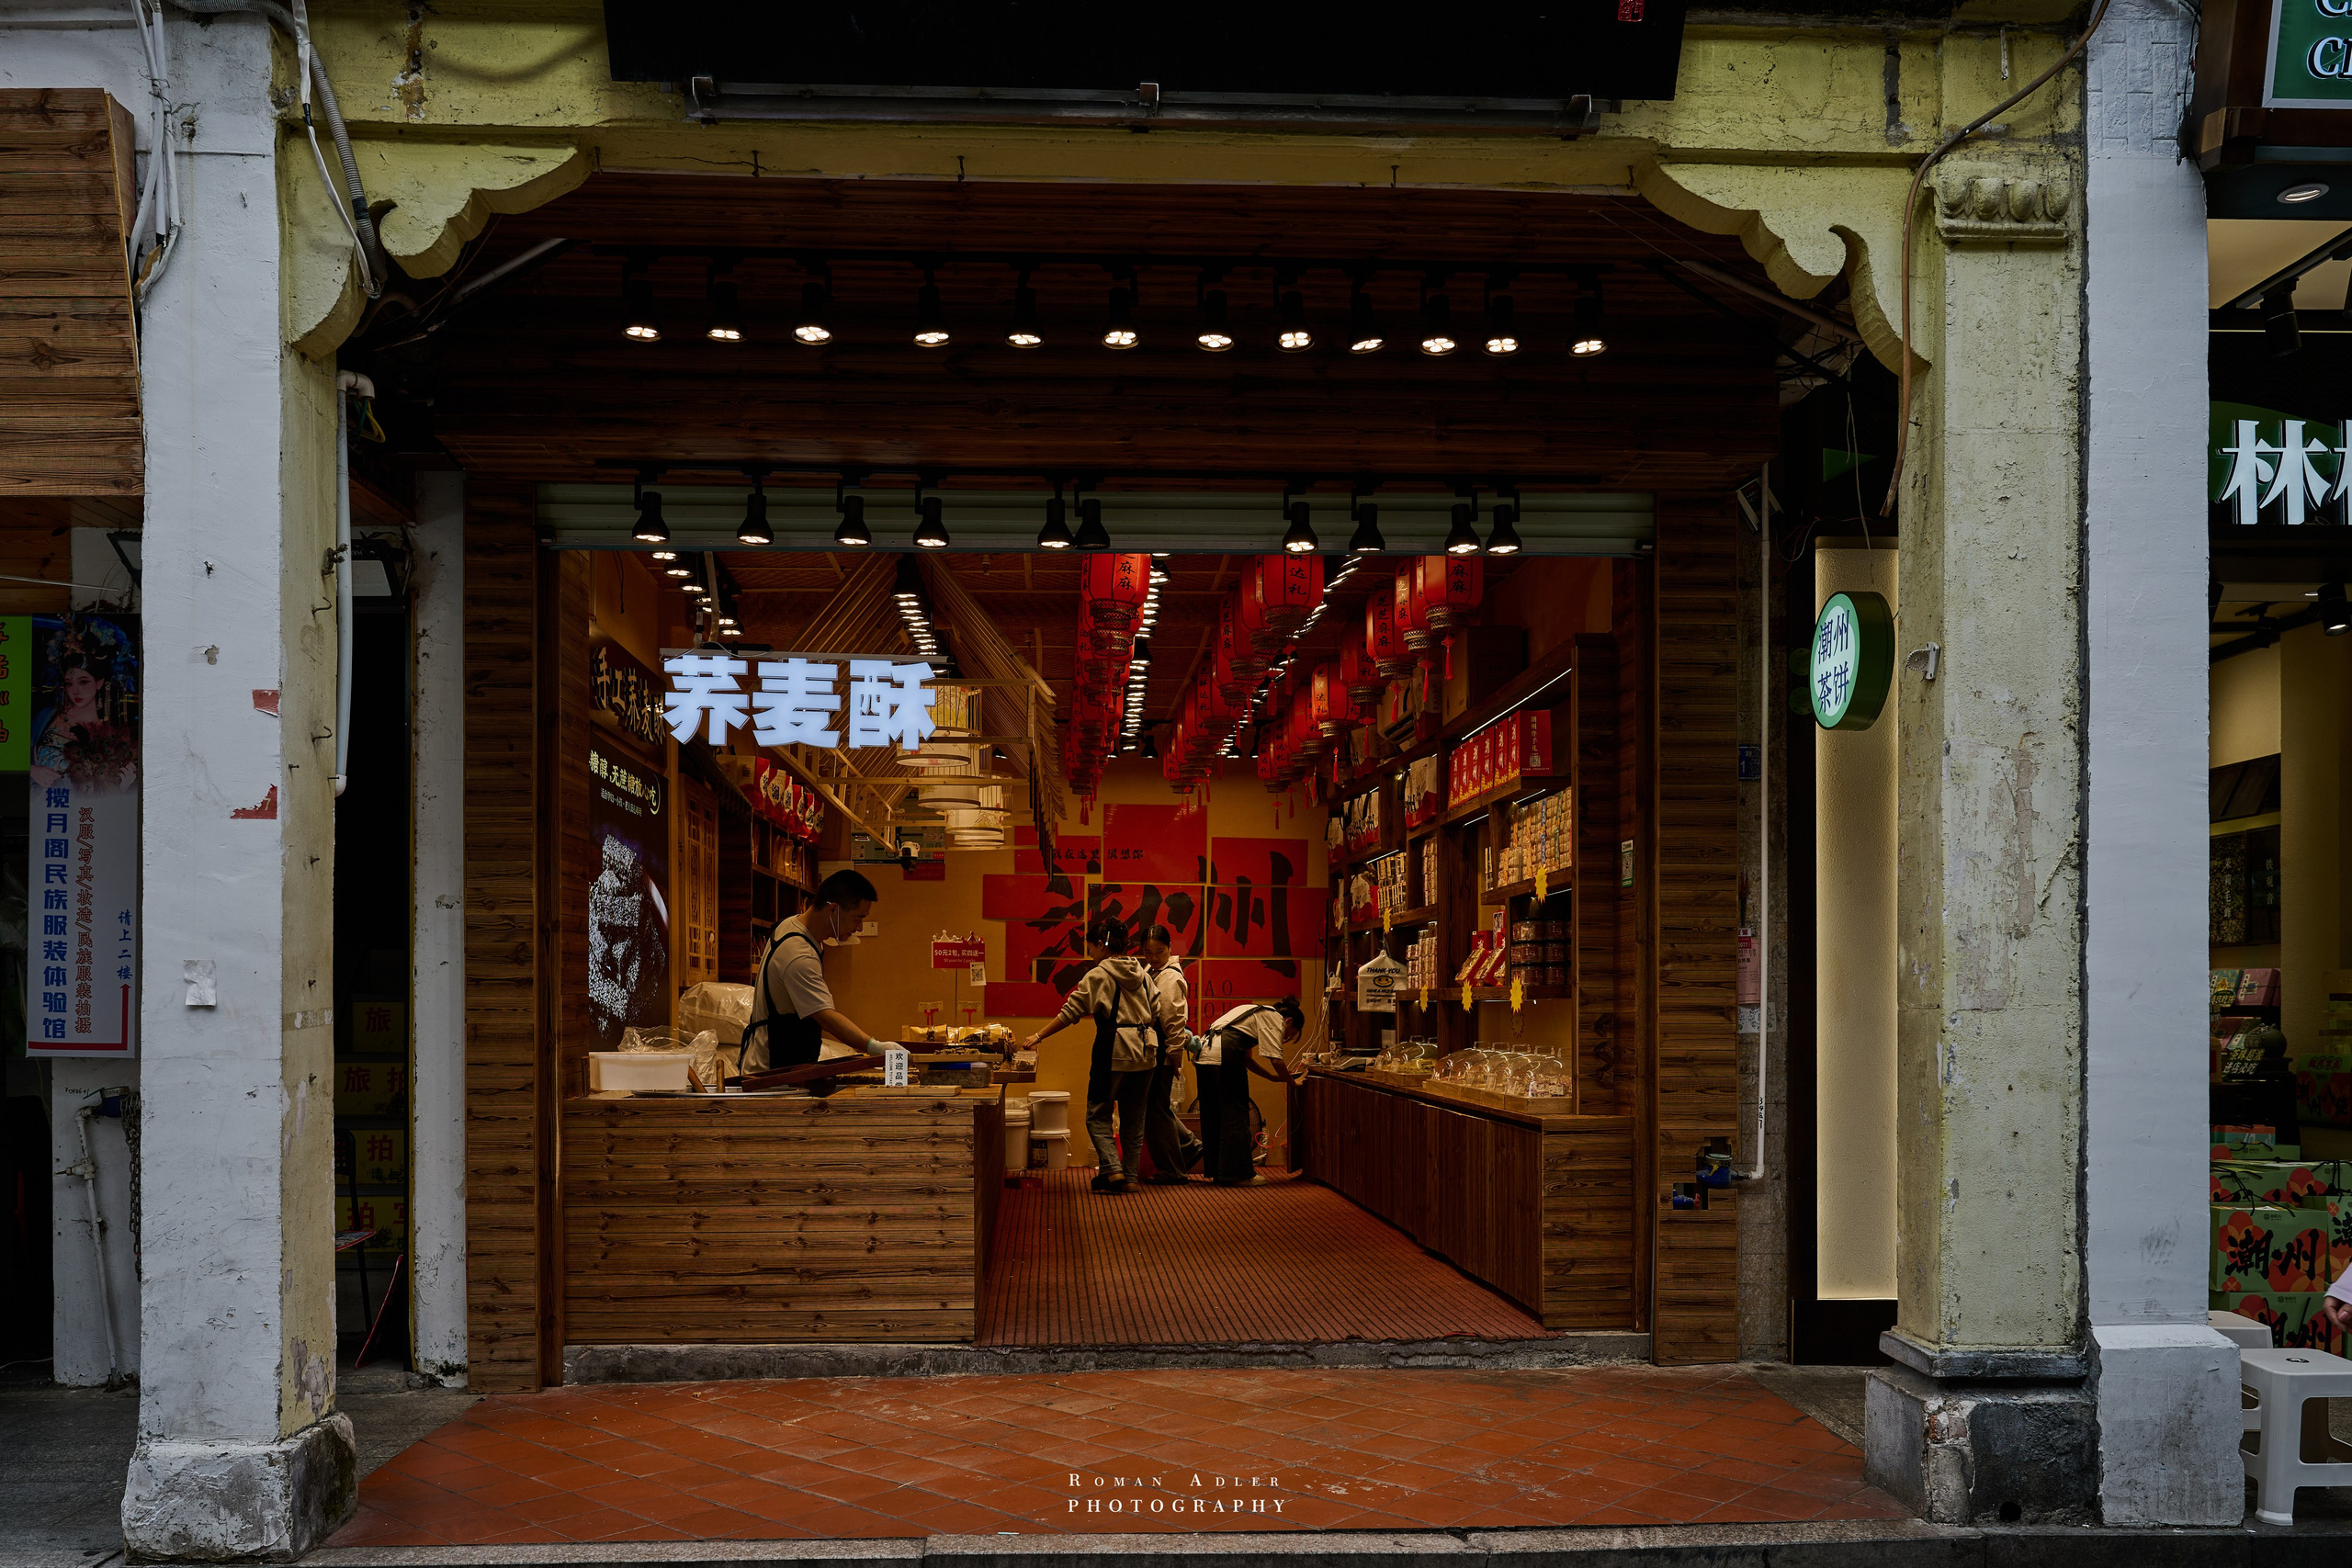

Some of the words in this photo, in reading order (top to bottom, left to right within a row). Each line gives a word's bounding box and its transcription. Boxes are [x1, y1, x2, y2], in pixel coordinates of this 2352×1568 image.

[2216, 419, 2352, 525] 林
[1117, 554, 1136, 591] 麻麻
[1450, 556, 1468, 593] 麻麻
[1818, 609, 1849, 665] 潮州
[662, 655, 937, 750] 荞麦酥
[1817, 660, 1849, 714] 茶饼
[42, 787, 70, 1039] 揽月阁民族服装体验馆
